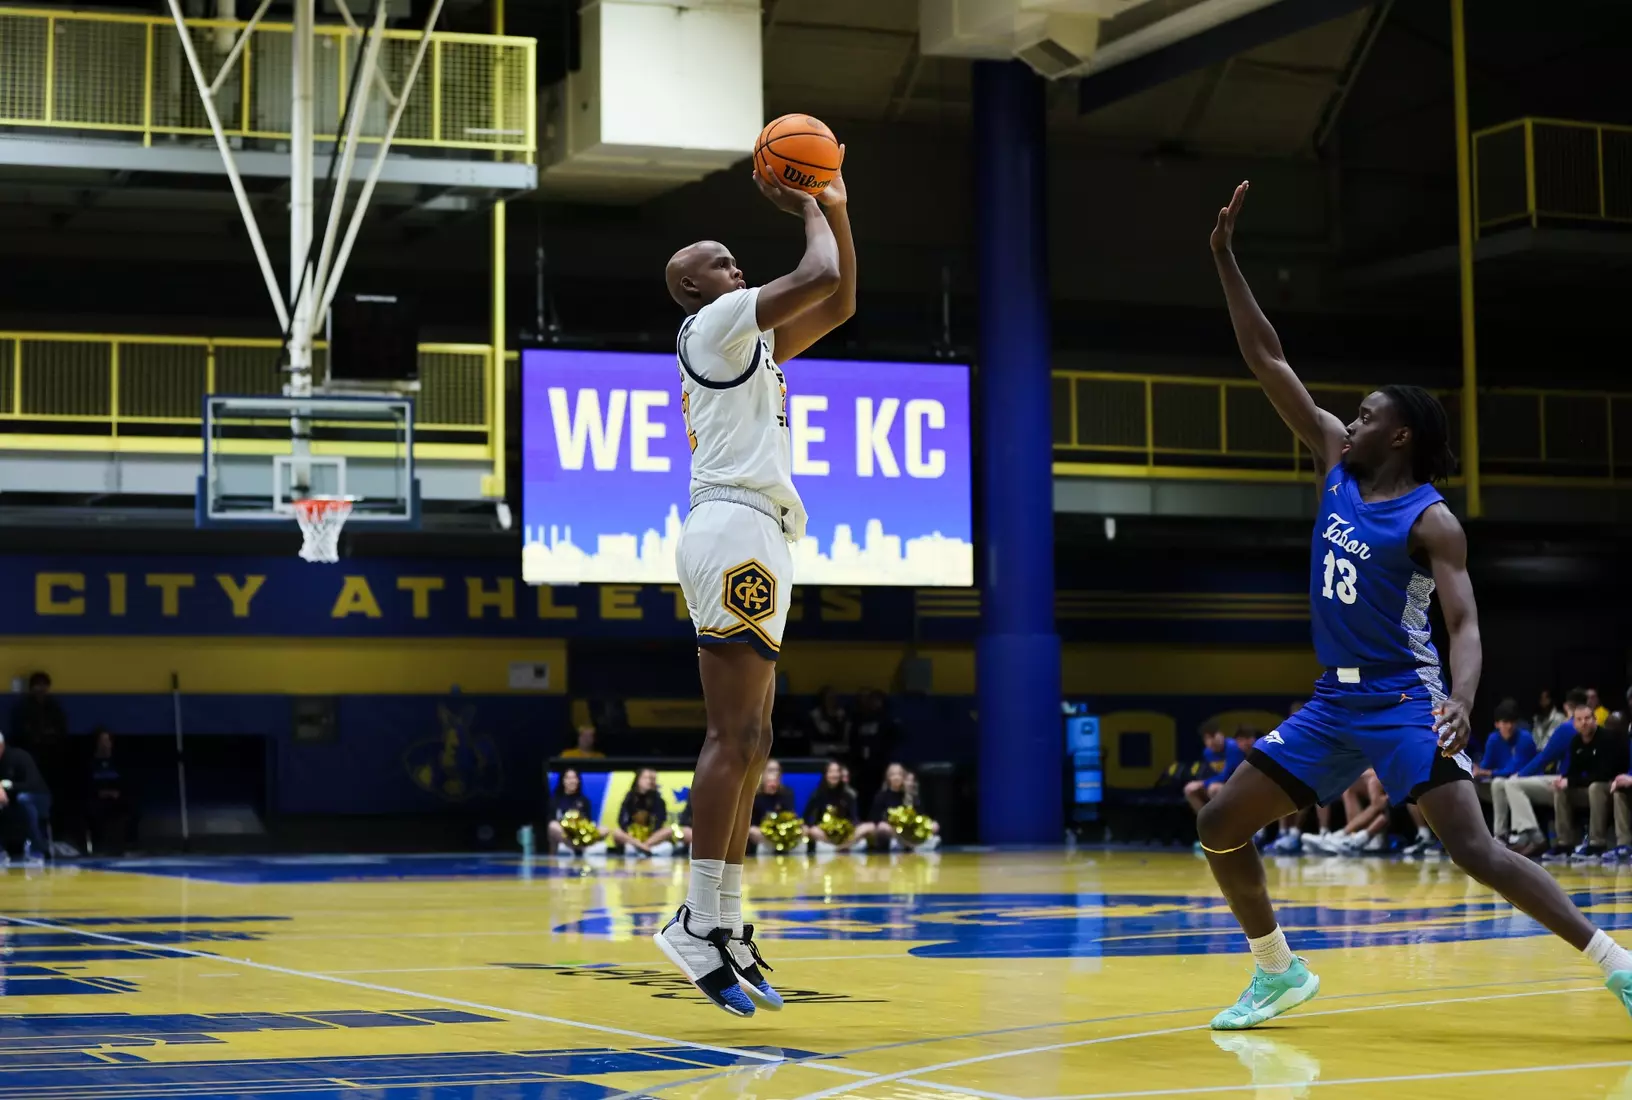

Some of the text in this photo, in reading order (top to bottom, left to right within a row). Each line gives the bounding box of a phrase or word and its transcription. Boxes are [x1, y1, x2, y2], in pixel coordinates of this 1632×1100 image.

[783, 164, 832, 189] Wilson
[547, 387, 671, 472] WE
[856, 397, 946, 479] KC
[1322, 512, 1371, 561] Tabor
[35, 572, 863, 621] CITY ATHLETS
[1322, 549, 1358, 605] 13
